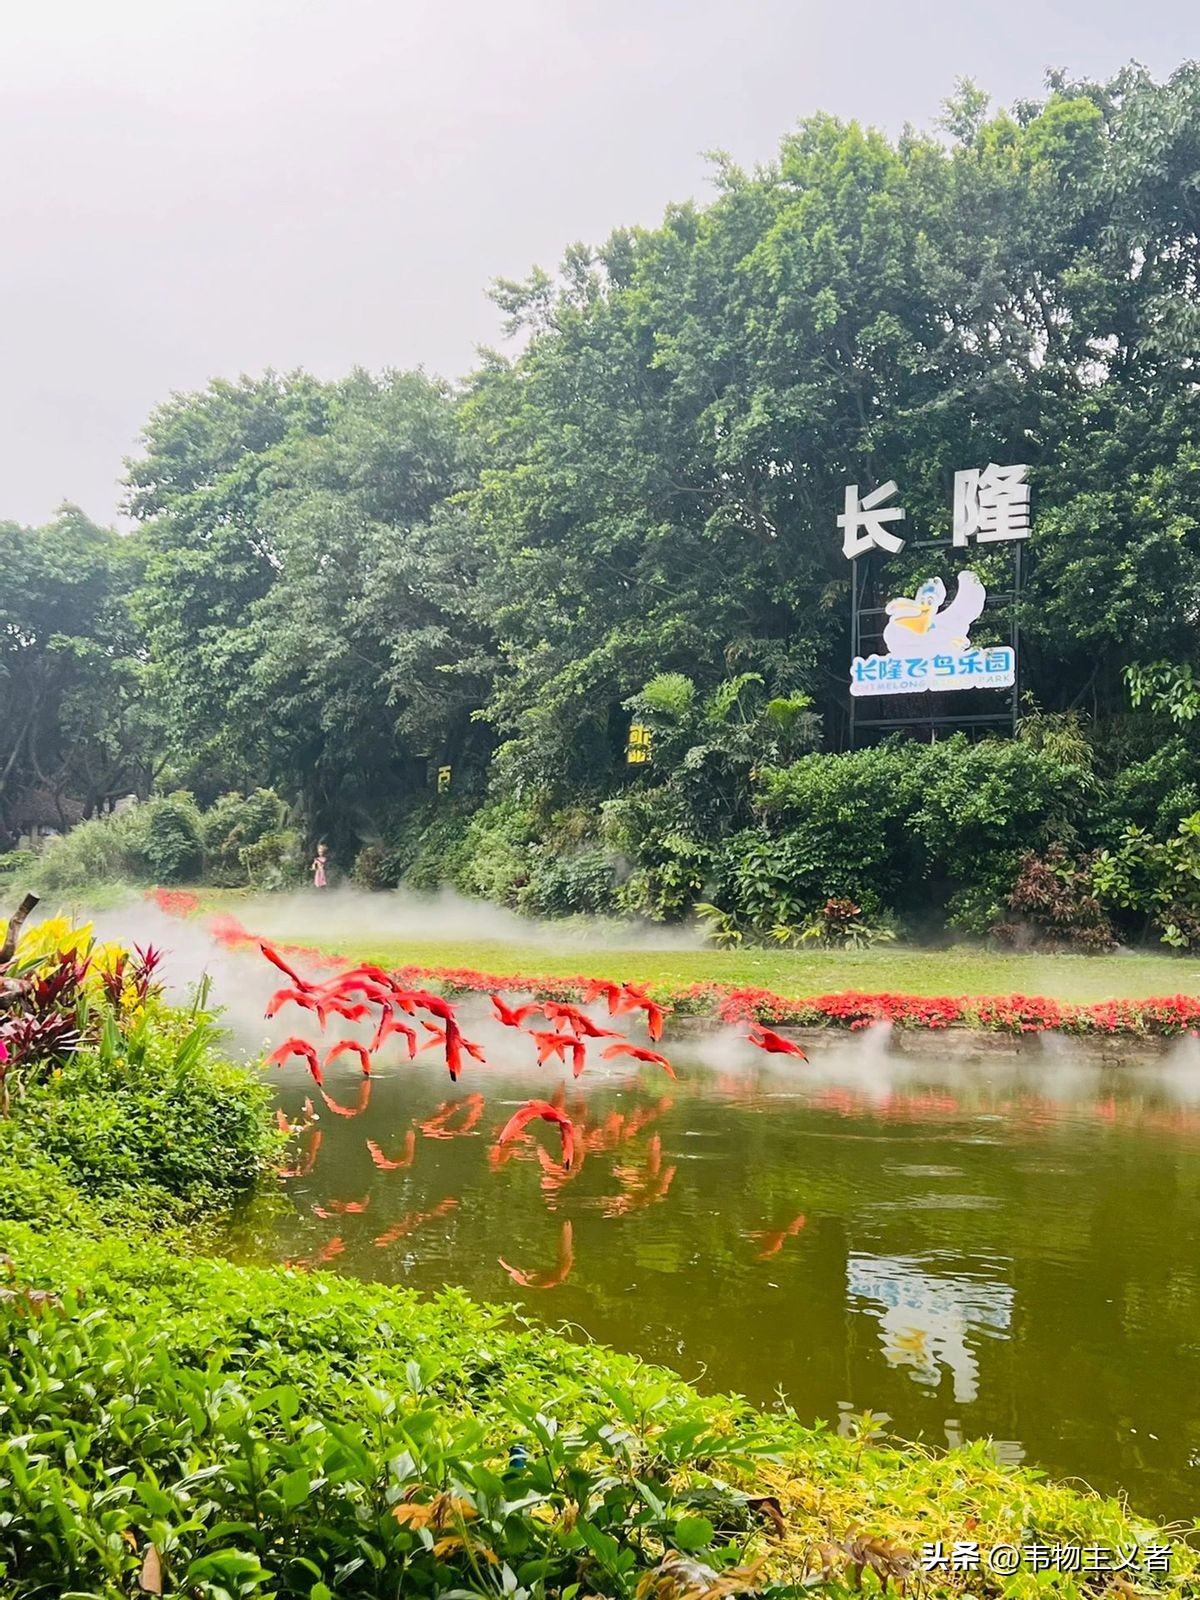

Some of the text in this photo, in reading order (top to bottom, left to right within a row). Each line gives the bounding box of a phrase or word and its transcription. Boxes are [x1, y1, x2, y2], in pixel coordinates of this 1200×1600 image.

[837, 463, 1031, 559] 长隆
[855, 651, 1010, 682] 长隆飞鸟乐园
